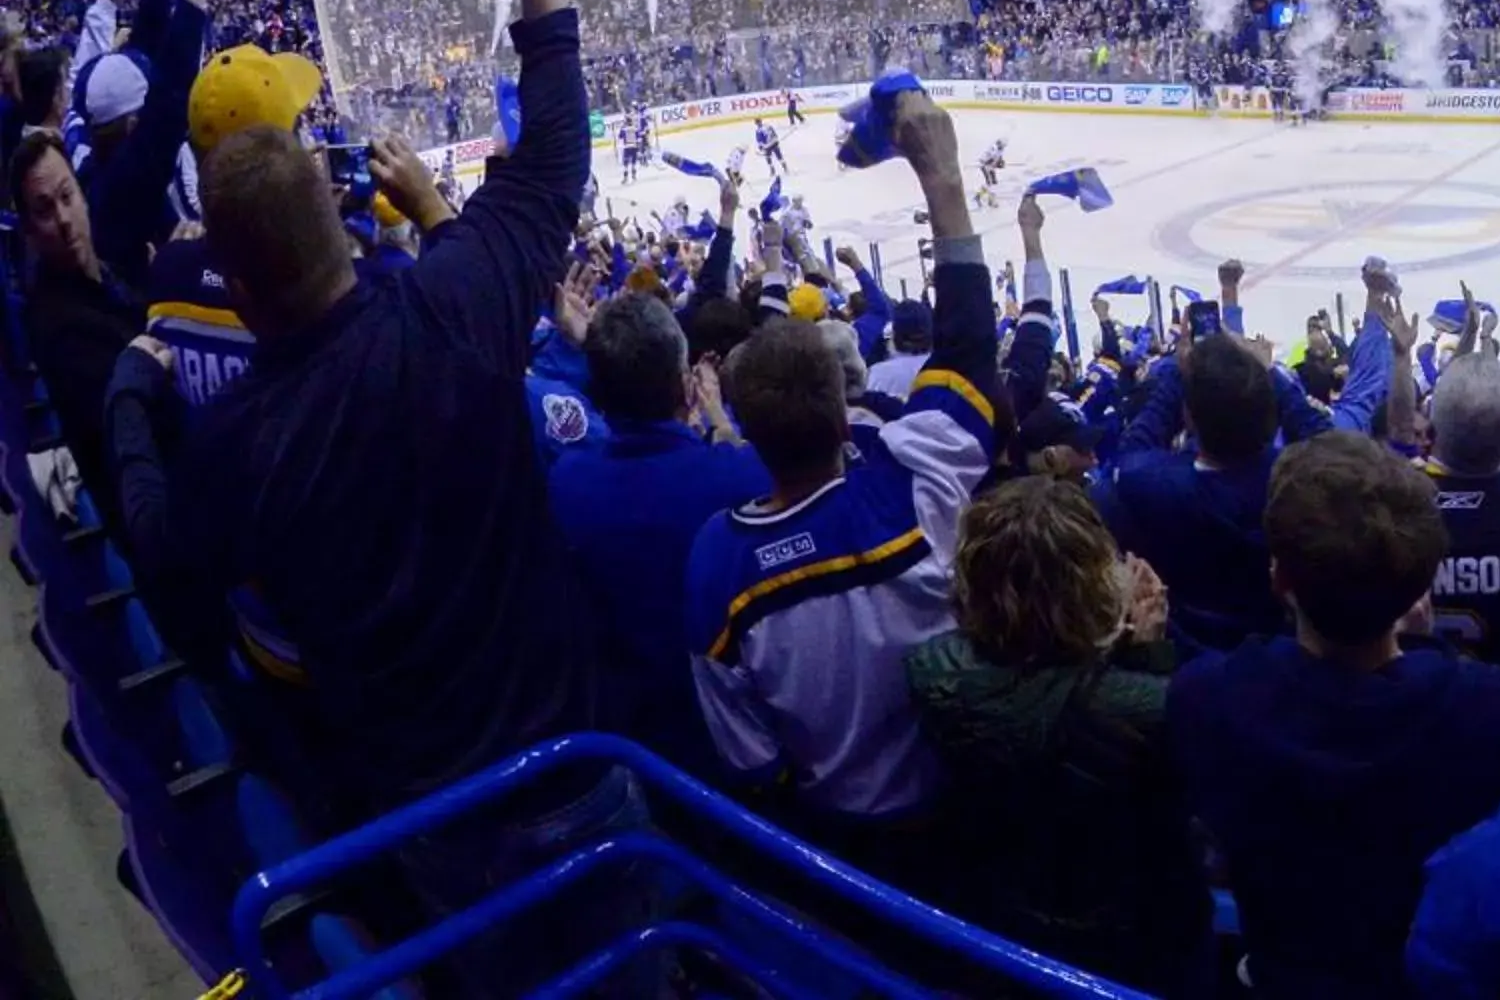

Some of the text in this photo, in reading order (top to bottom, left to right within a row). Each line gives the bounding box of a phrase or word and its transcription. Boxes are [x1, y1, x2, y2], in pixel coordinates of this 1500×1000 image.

[1047, 86, 1113, 102] GEICO
[661, 101, 722, 123] DISCOVER
[760, 538, 811, 566] CCM
